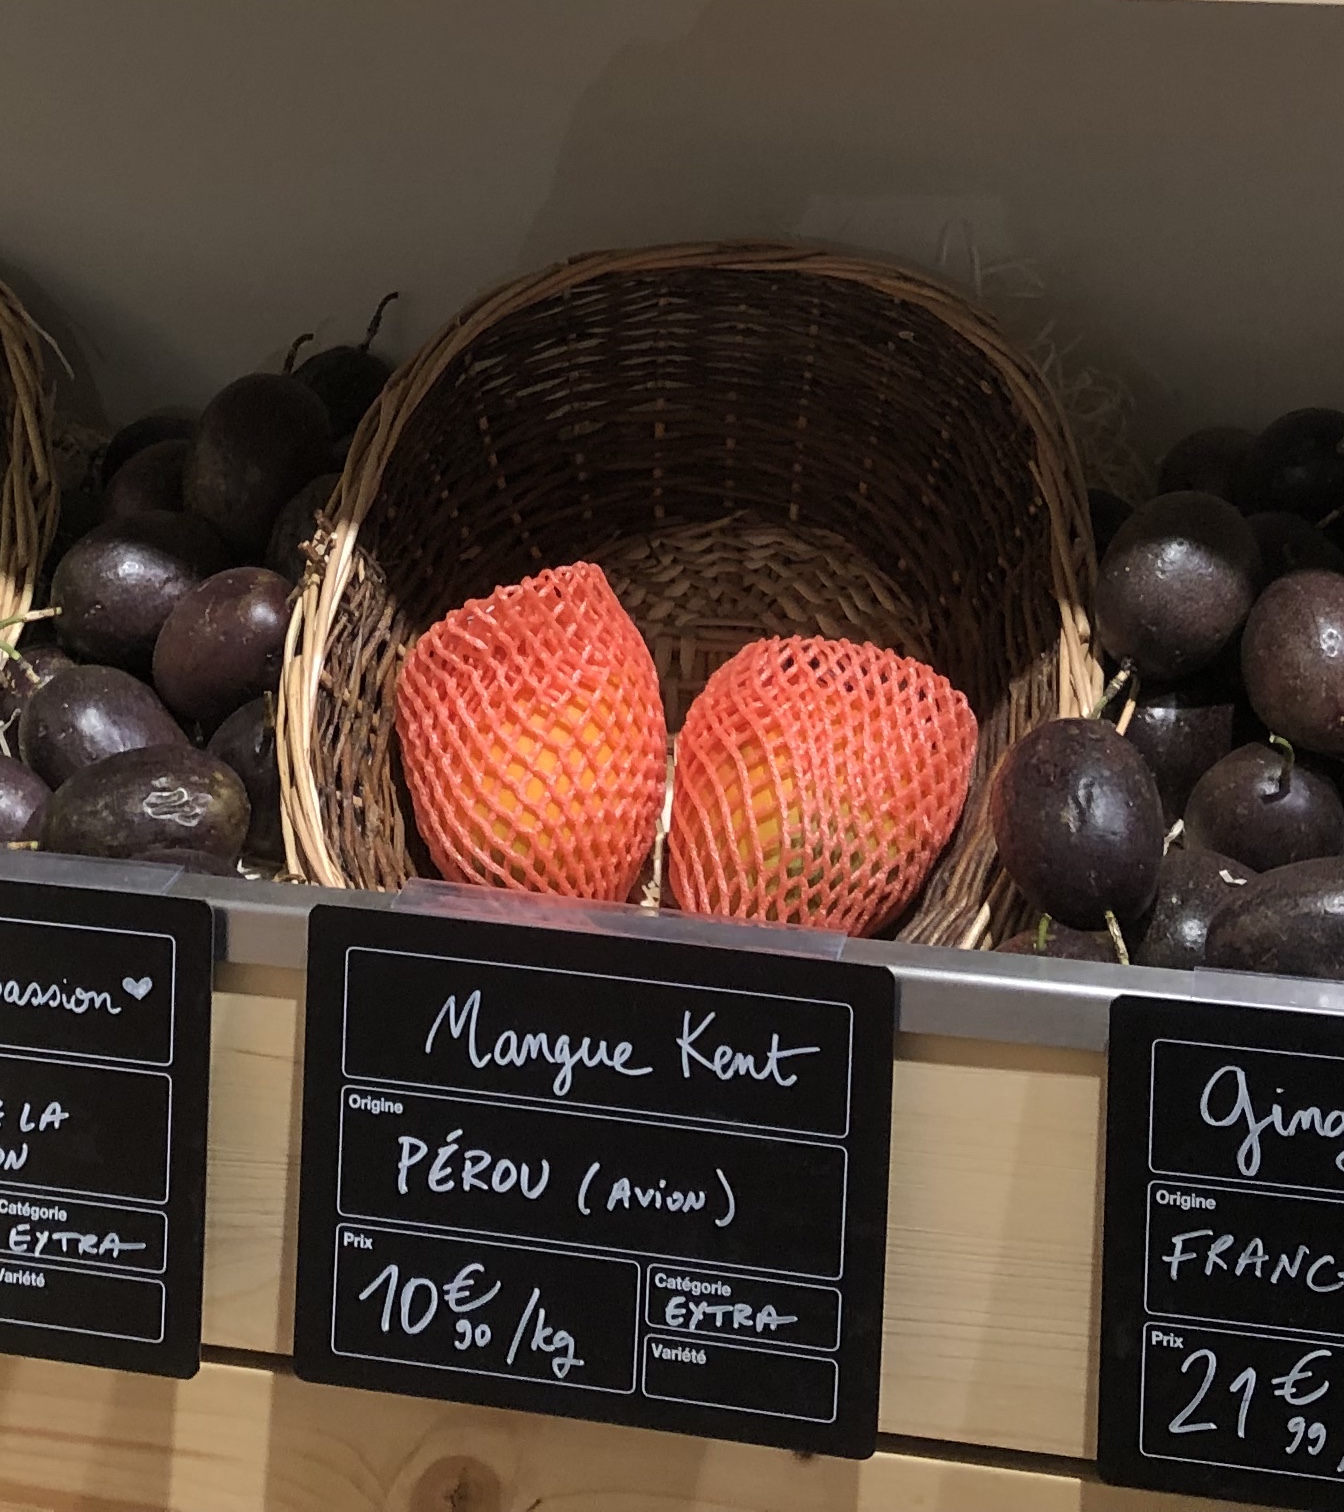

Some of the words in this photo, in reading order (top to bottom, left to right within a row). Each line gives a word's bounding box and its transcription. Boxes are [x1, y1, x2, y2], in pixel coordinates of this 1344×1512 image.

[425, 989, 653, 1096] Mangue
[676, 1010, 820, 1088] Kent
[348, 1095, 405, 1115] Origine
[19, 1101, 69, 1132] LA
[397, 1128, 552, 1200] PÉROU
[1155, 1189, 1217, 1210] Origine
[344, 1232, 374, 1250] Prix
[654, 1273, 732, 1297] Catégorie
[1151, 1331, 1185, 1349] Prix
[651, 1343, 707, 1365] Variété
